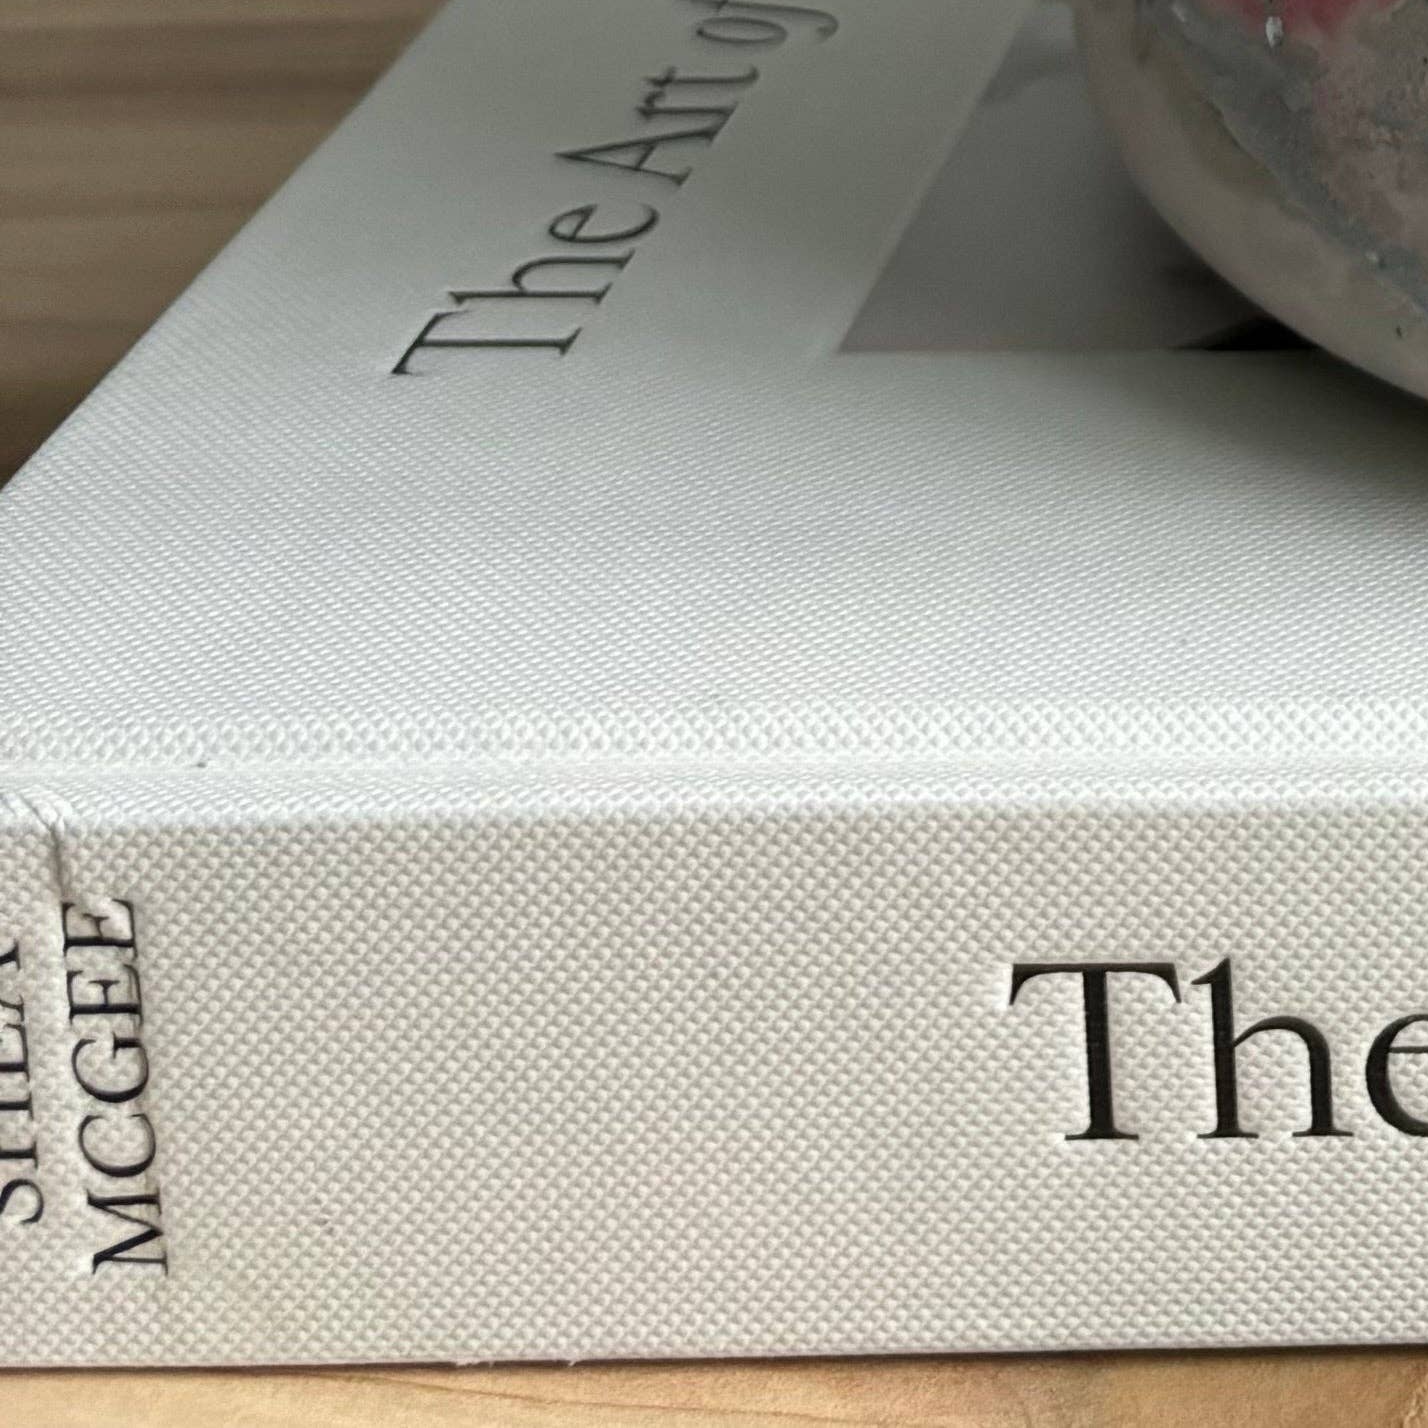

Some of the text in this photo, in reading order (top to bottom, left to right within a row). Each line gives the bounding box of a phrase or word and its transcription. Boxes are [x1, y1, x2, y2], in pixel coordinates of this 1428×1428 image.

[391, 204, 660, 376] The
[554, 65, 760, 187] Art
[61, 898, 168, 1276] MCGEE
